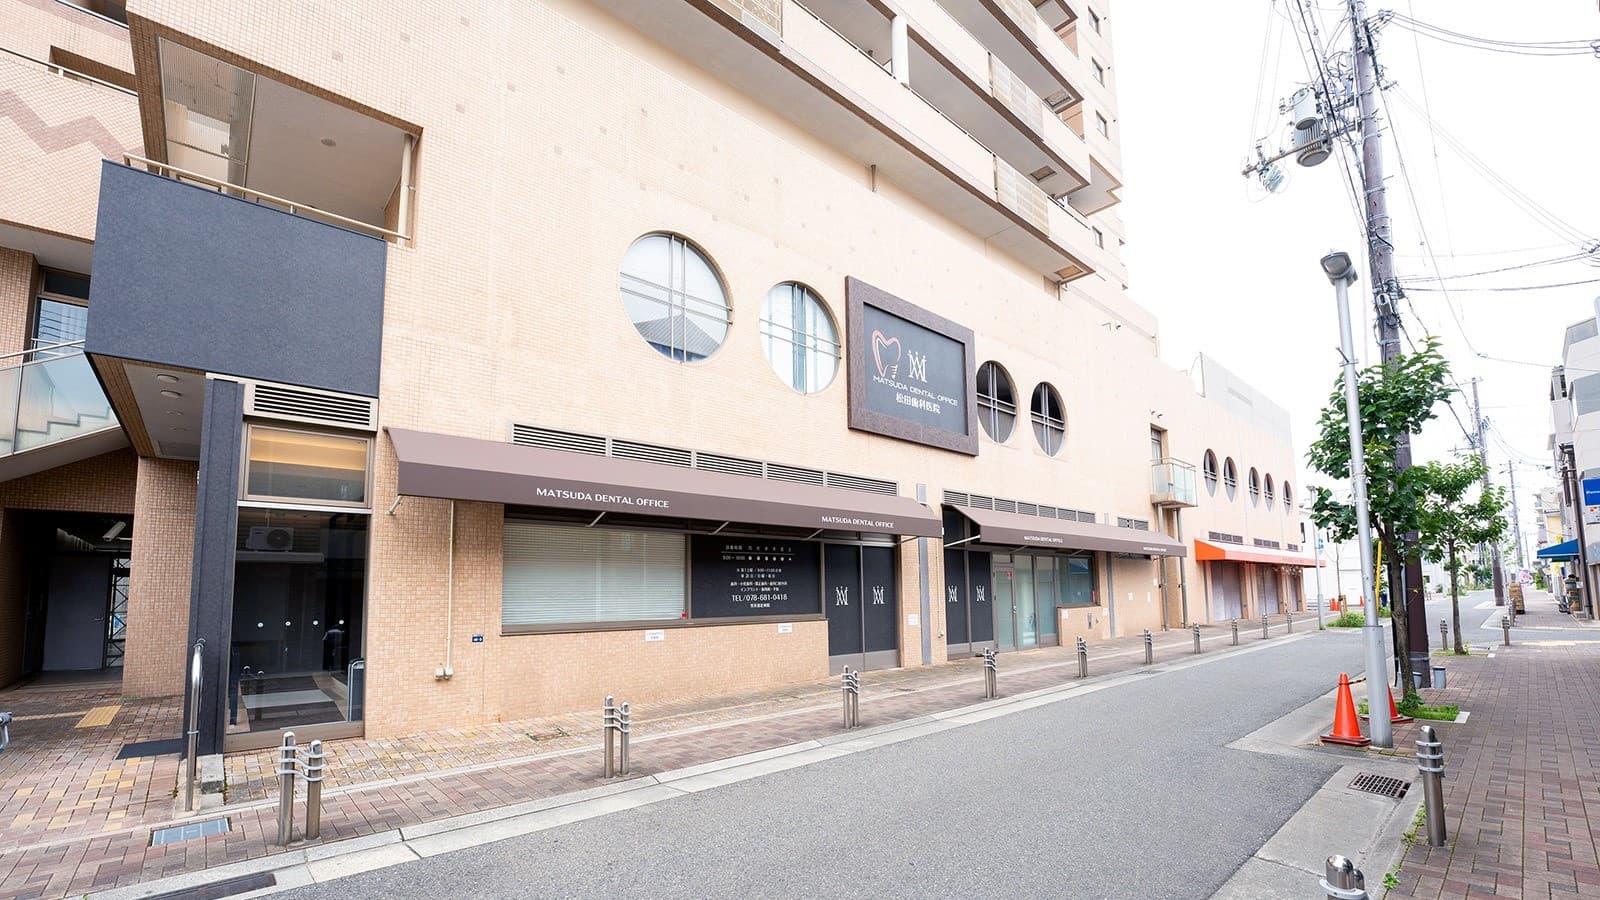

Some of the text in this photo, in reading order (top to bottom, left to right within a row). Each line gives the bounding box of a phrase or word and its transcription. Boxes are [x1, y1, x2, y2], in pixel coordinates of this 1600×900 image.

[873, 375, 959, 406] MATSUDA DENTAL OFFICE
[536, 487, 670, 508] MATSUDA DENTAL OFFICE
[821, 516, 895, 529] MATSUDA DENTAL OFFICE
